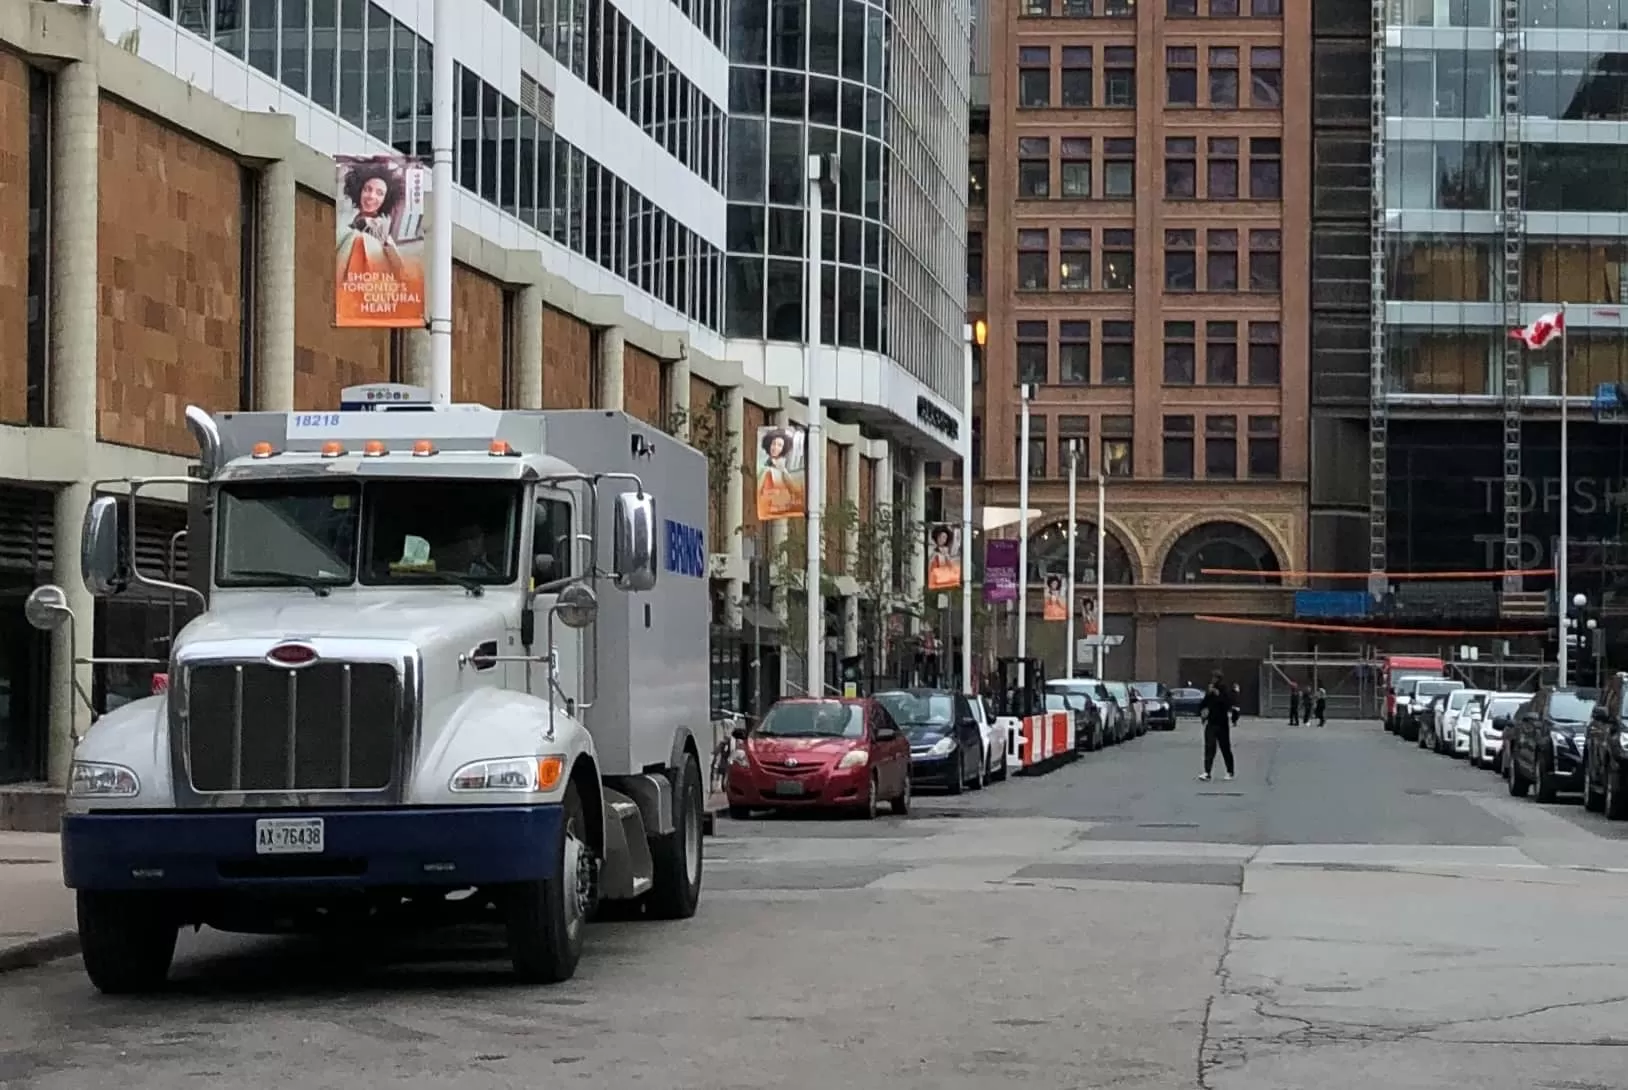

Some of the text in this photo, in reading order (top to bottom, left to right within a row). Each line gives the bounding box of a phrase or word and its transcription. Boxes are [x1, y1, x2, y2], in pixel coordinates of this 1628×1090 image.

[347, 272, 394, 281] SHOP IN
[343, 282, 407, 292] TORONTO'S
[363, 293, 421, 303] CULTURAL
[360, 303, 397, 313] HEART
[295, 414, 340, 426] 18218
